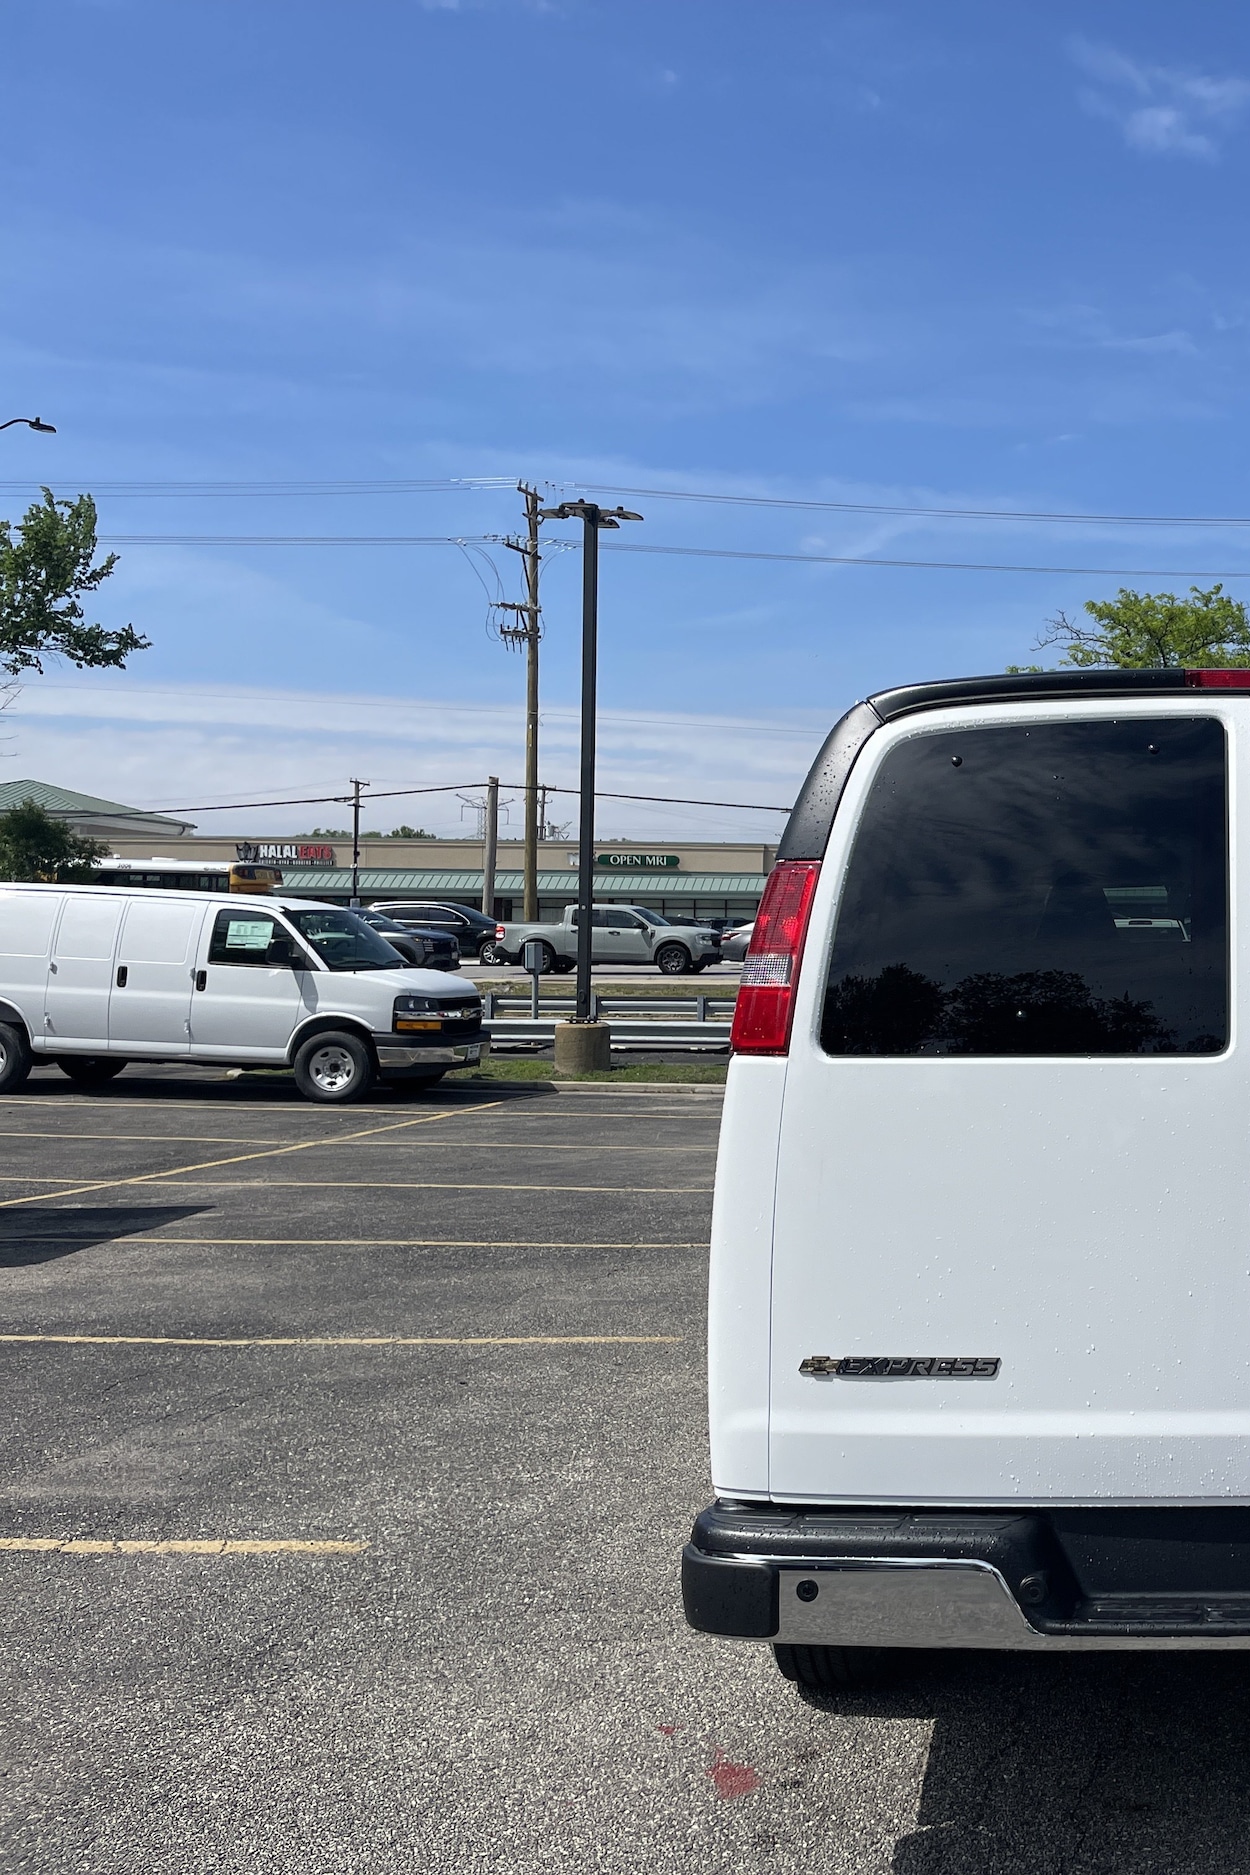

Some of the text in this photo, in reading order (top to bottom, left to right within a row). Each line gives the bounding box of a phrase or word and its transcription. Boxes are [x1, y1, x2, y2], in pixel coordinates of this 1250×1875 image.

[259, 844, 332, 860] HALAL EATS
[609, 854, 642, 865] OPEN
[645, 855, 667, 866] MRI
[839, 1357, 1000, 1376] EXPRESS
